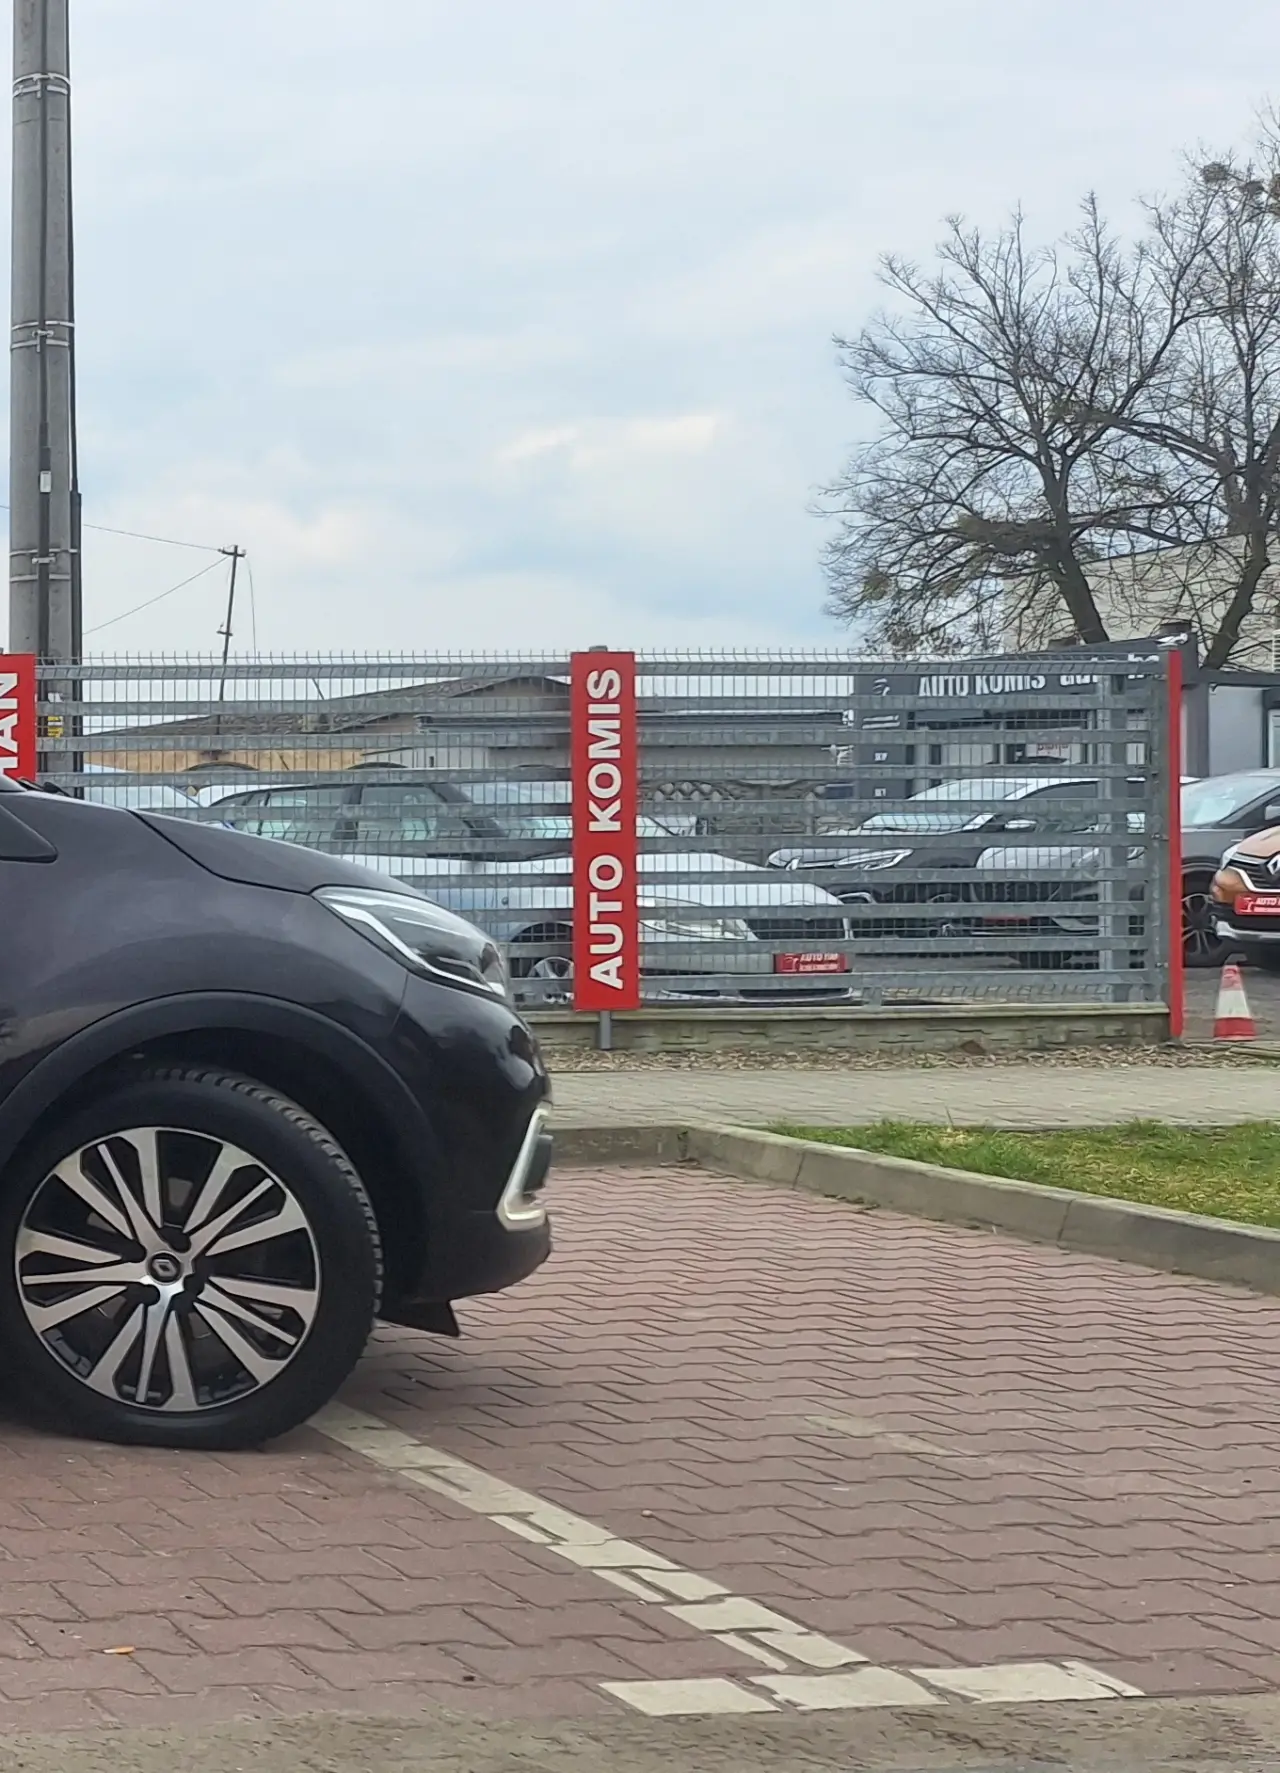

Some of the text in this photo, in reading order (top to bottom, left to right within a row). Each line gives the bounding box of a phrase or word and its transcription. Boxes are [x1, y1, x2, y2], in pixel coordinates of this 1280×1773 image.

[918, 674, 970, 697] AUTO
[975, 673, 1047, 695] KOMIS
[586, 668, 624, 990] AUTO KOMIS
